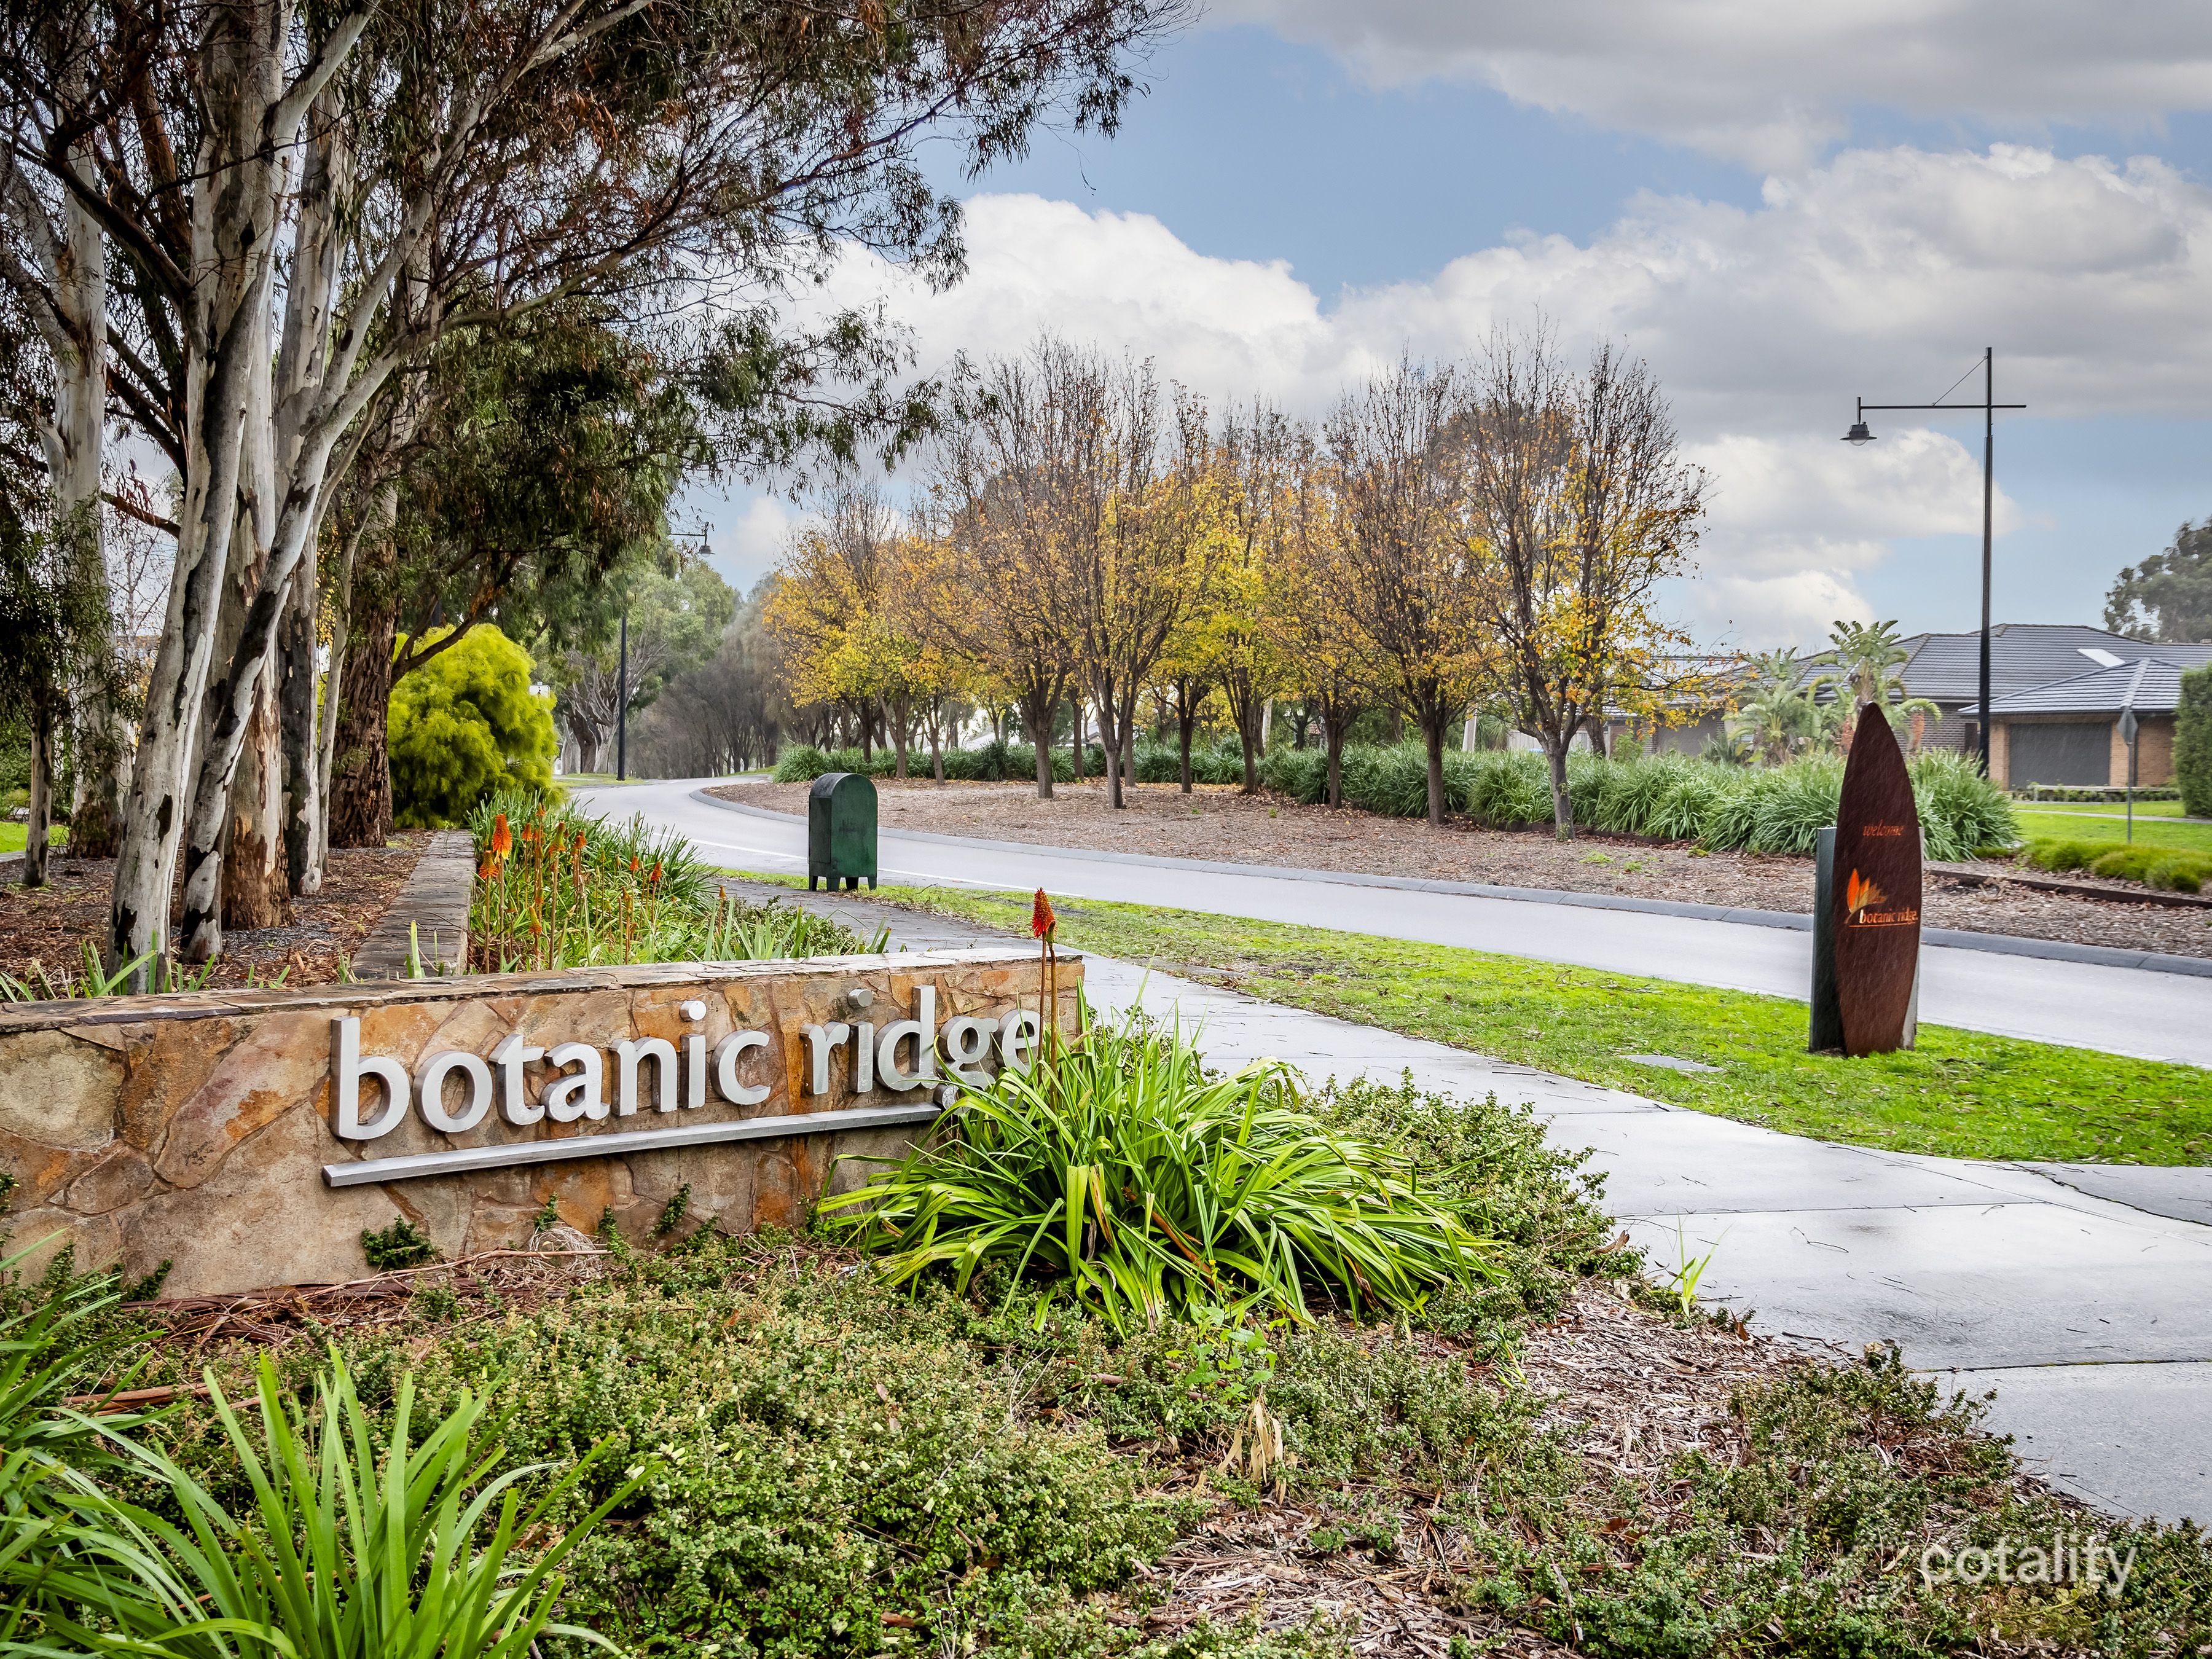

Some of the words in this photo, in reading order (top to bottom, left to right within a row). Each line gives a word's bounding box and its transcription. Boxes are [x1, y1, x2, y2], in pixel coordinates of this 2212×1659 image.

[1863, 819, 1904, 836] welcome
[1859, 908, 1896, 924] botanic
[1897, 906, 1918, 925] ridge
[330, 1000, 772, 1140] botanic
[800, 985, 1041, 1115] ridge
